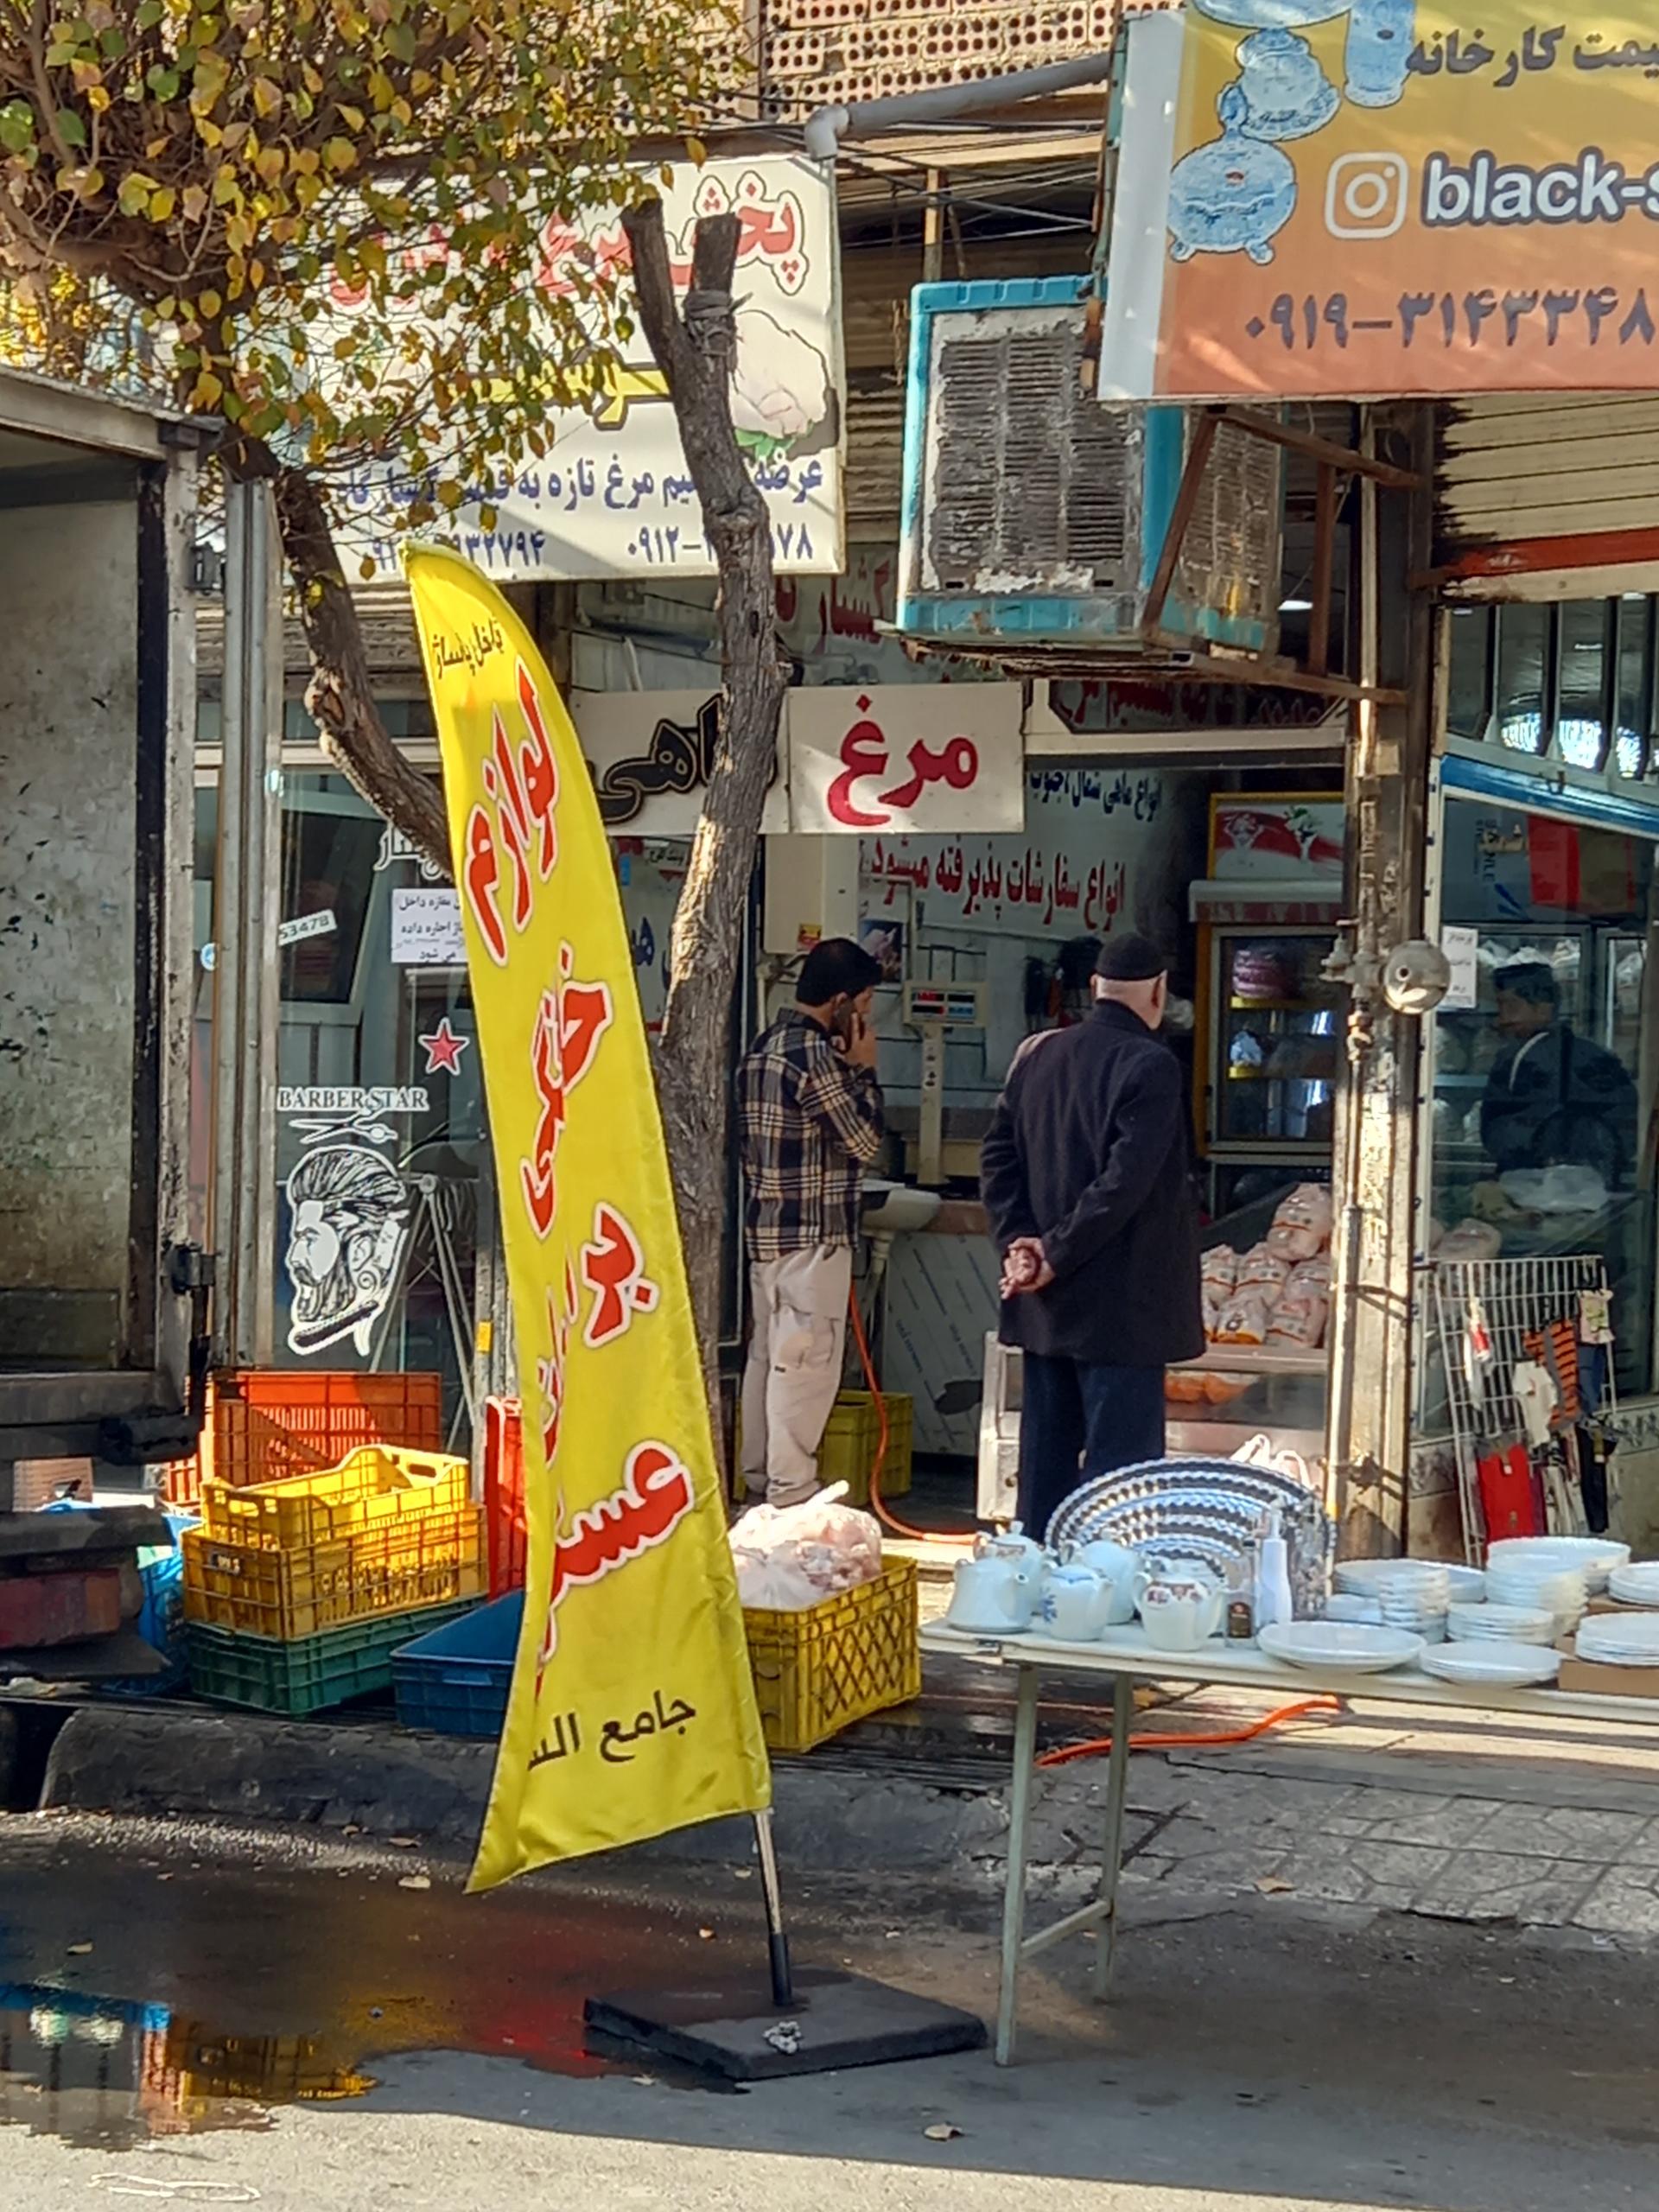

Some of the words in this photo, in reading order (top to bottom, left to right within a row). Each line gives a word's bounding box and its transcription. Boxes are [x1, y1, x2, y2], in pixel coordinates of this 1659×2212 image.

[1405, 25, 1567, 87] کارخانه
[1573, 32, 1659, 79] یمت
[518, 471, 540, 510] به
[549, 457, 594, 511] تازه
[604, 454, 654, 510] مرغ
[826, 694, 979, 827] مرغ
[464, 653, 560, 967] لوازم
[1084, 860, 1125, 932] انواع
[278, 1089, 365, 1109] BARBER
[368, 1089, 427, 1109] STAR
[600, 1690, 696, 1764] جامع
